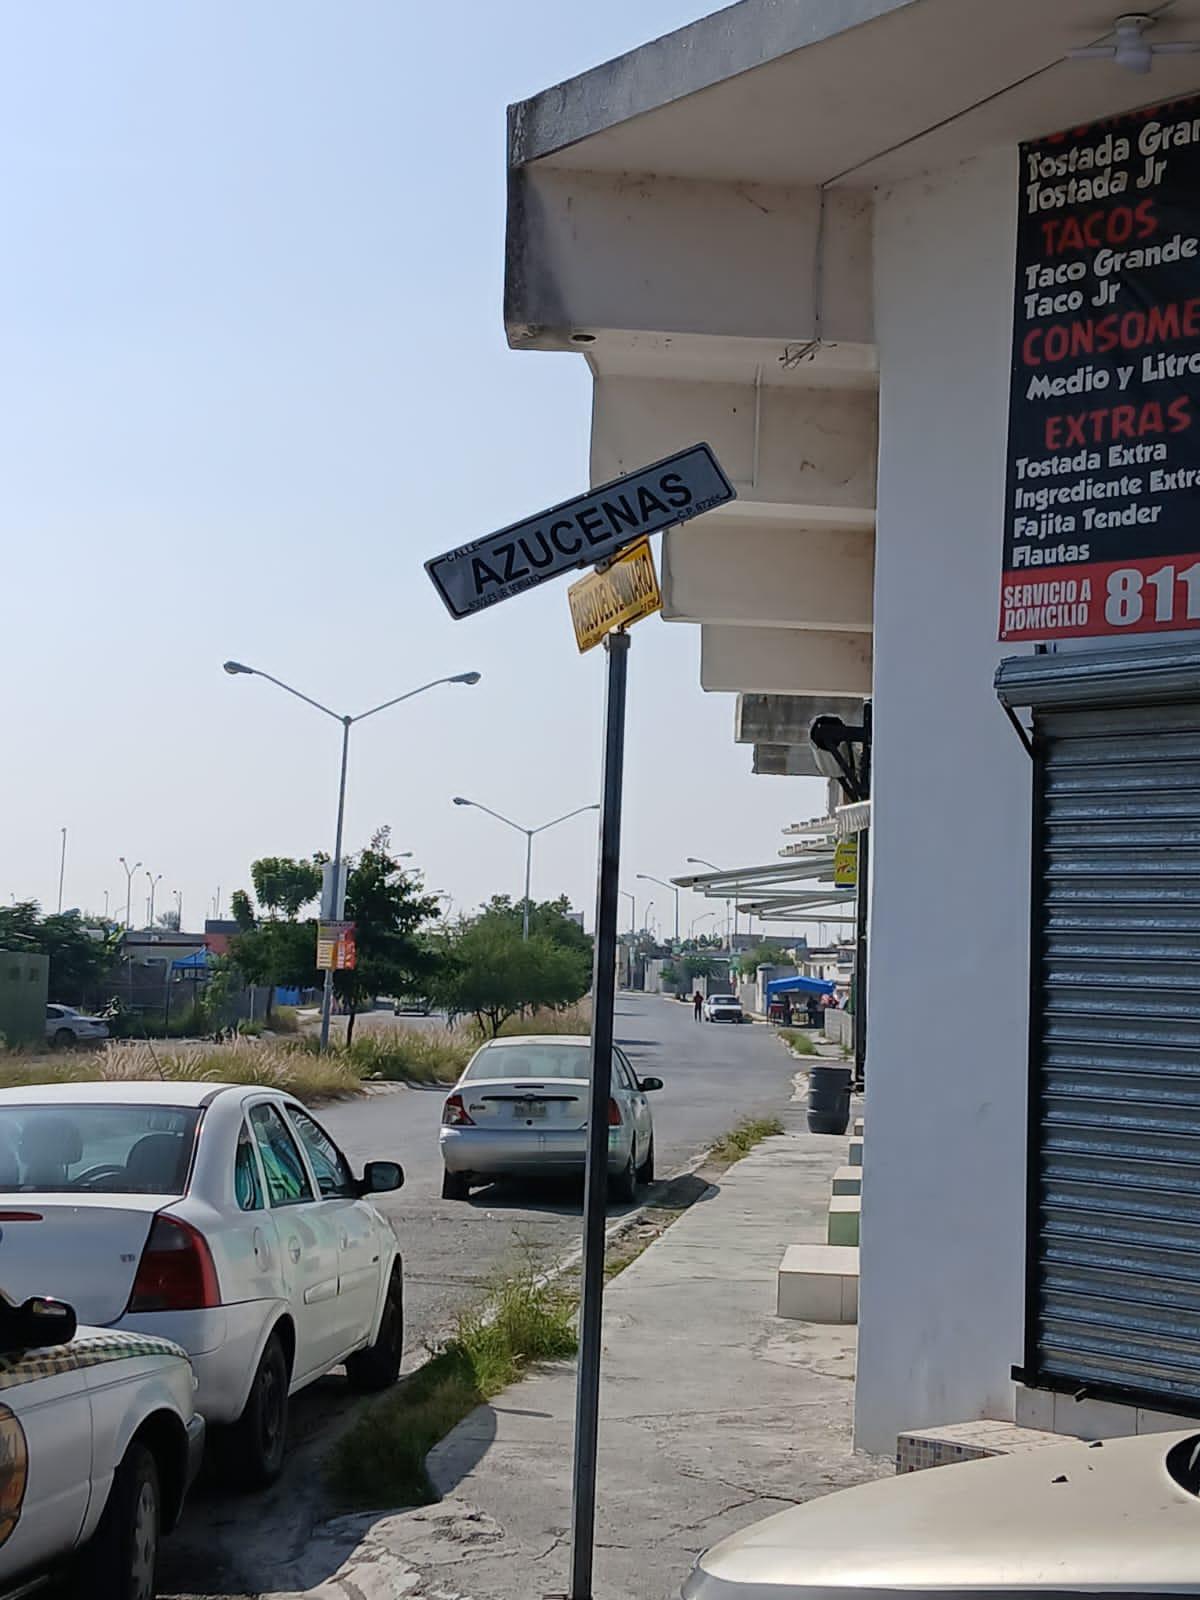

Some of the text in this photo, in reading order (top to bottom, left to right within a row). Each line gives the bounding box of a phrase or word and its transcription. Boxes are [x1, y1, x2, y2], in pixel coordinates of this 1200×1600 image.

[1027, 134, 1129, 181] Tostada
[1027, 156, 1167, 213] Tostada Jr
[1041, 198, 1159, 256] TACOS
[1025, 234, 1199, 290] Taco Grande
[1024, 279, 1121, 319] Taco Jr
[1022, 297, 1200, 366] CONSOME
[1026, 352, 1200, 400] Medio y Litro
[1045, 394, 1191, 450] EXTRAS
[1016, 443, 1168, 480] Tostada Extra
[1015, 475, 1142, 511] Ingrediente
[471, 472, 692, 595] AZUCENAS
[1014, 503, 1162, 540] Fajita Tender
[446, 542, 480, 562] CALLE
[1012, 544, 1090, 568] Flautas
[1004, 578, 1091, 609] SERVICIO A
[1004, 603, 1088, 631] DOMICILIO
[1105, 562, 1200, 627] 811
